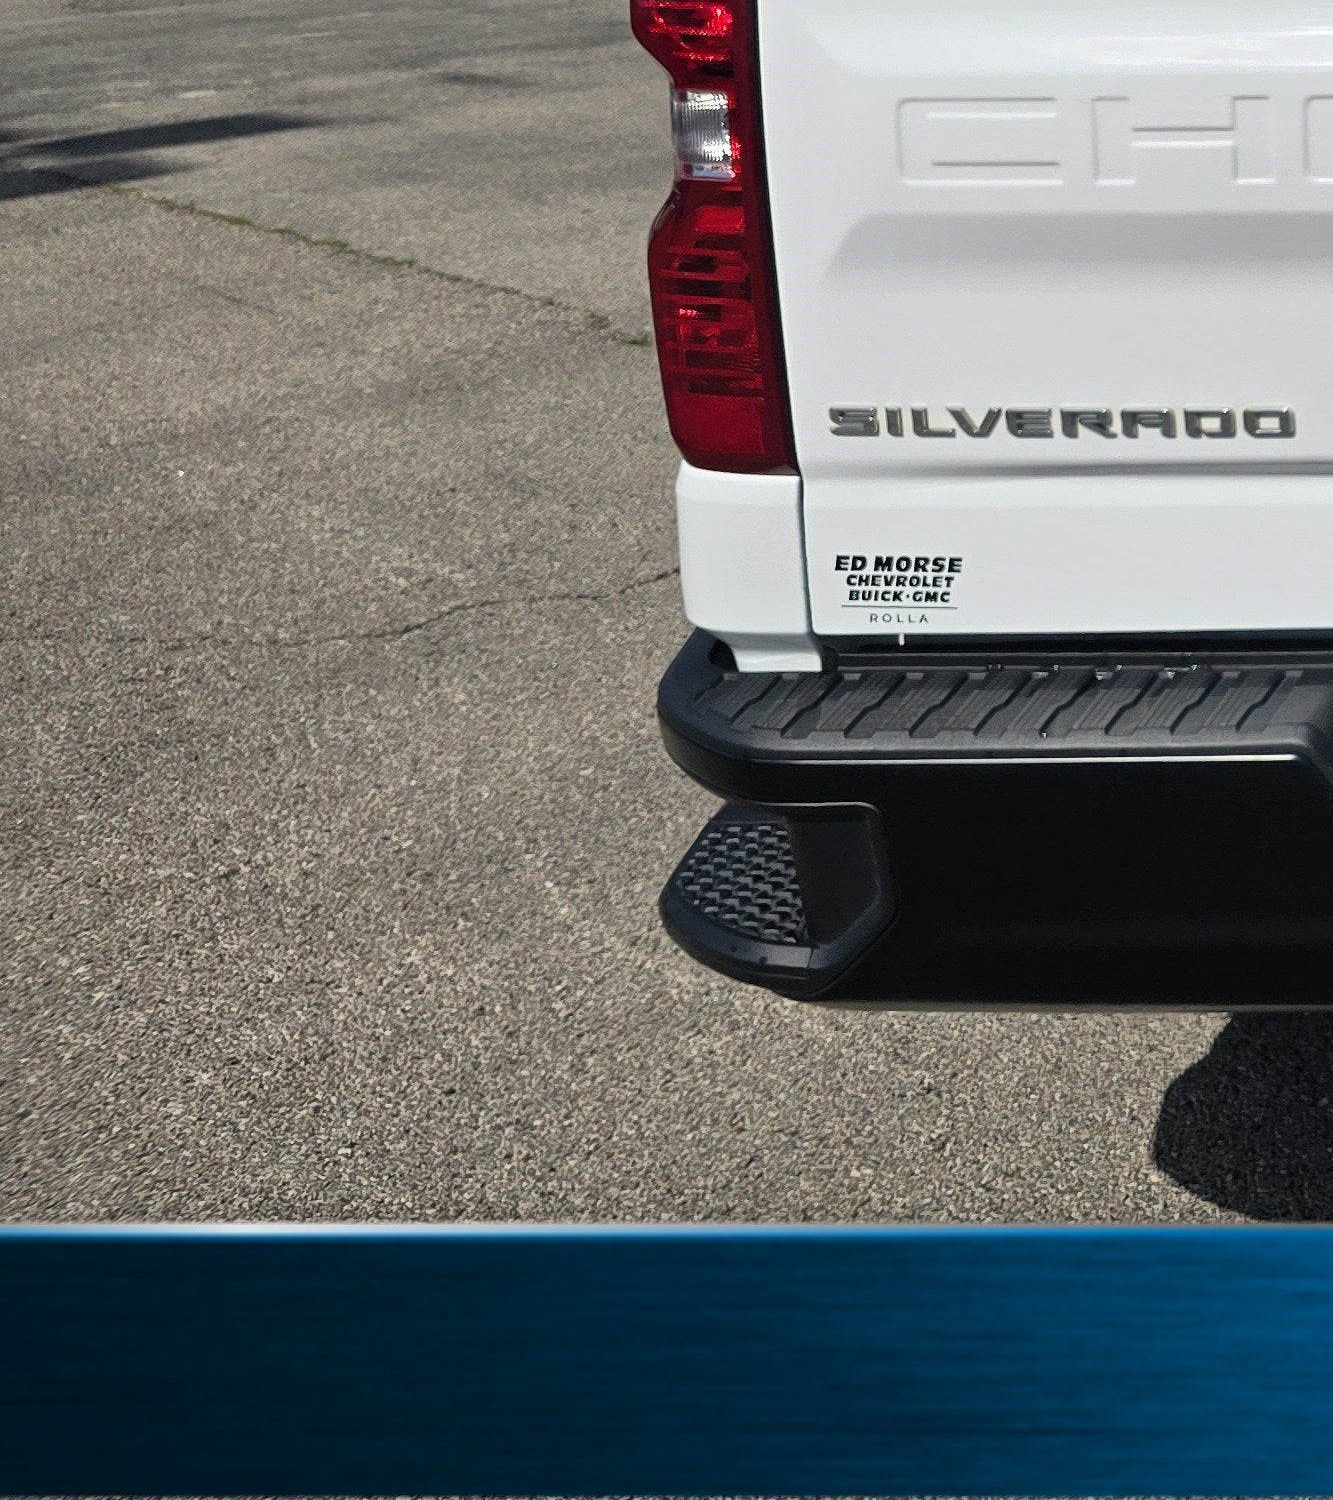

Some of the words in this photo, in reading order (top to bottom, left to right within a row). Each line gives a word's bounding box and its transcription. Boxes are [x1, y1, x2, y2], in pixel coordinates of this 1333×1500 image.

[828, 405, 1298, 441] SILVERADO
[834, 554, 867, 572] ED
[873, 555, 964, 574] MORSE
[846, 574, 955, 588] CHEVROLET
[869, 613, 929, 624] ROLLA
